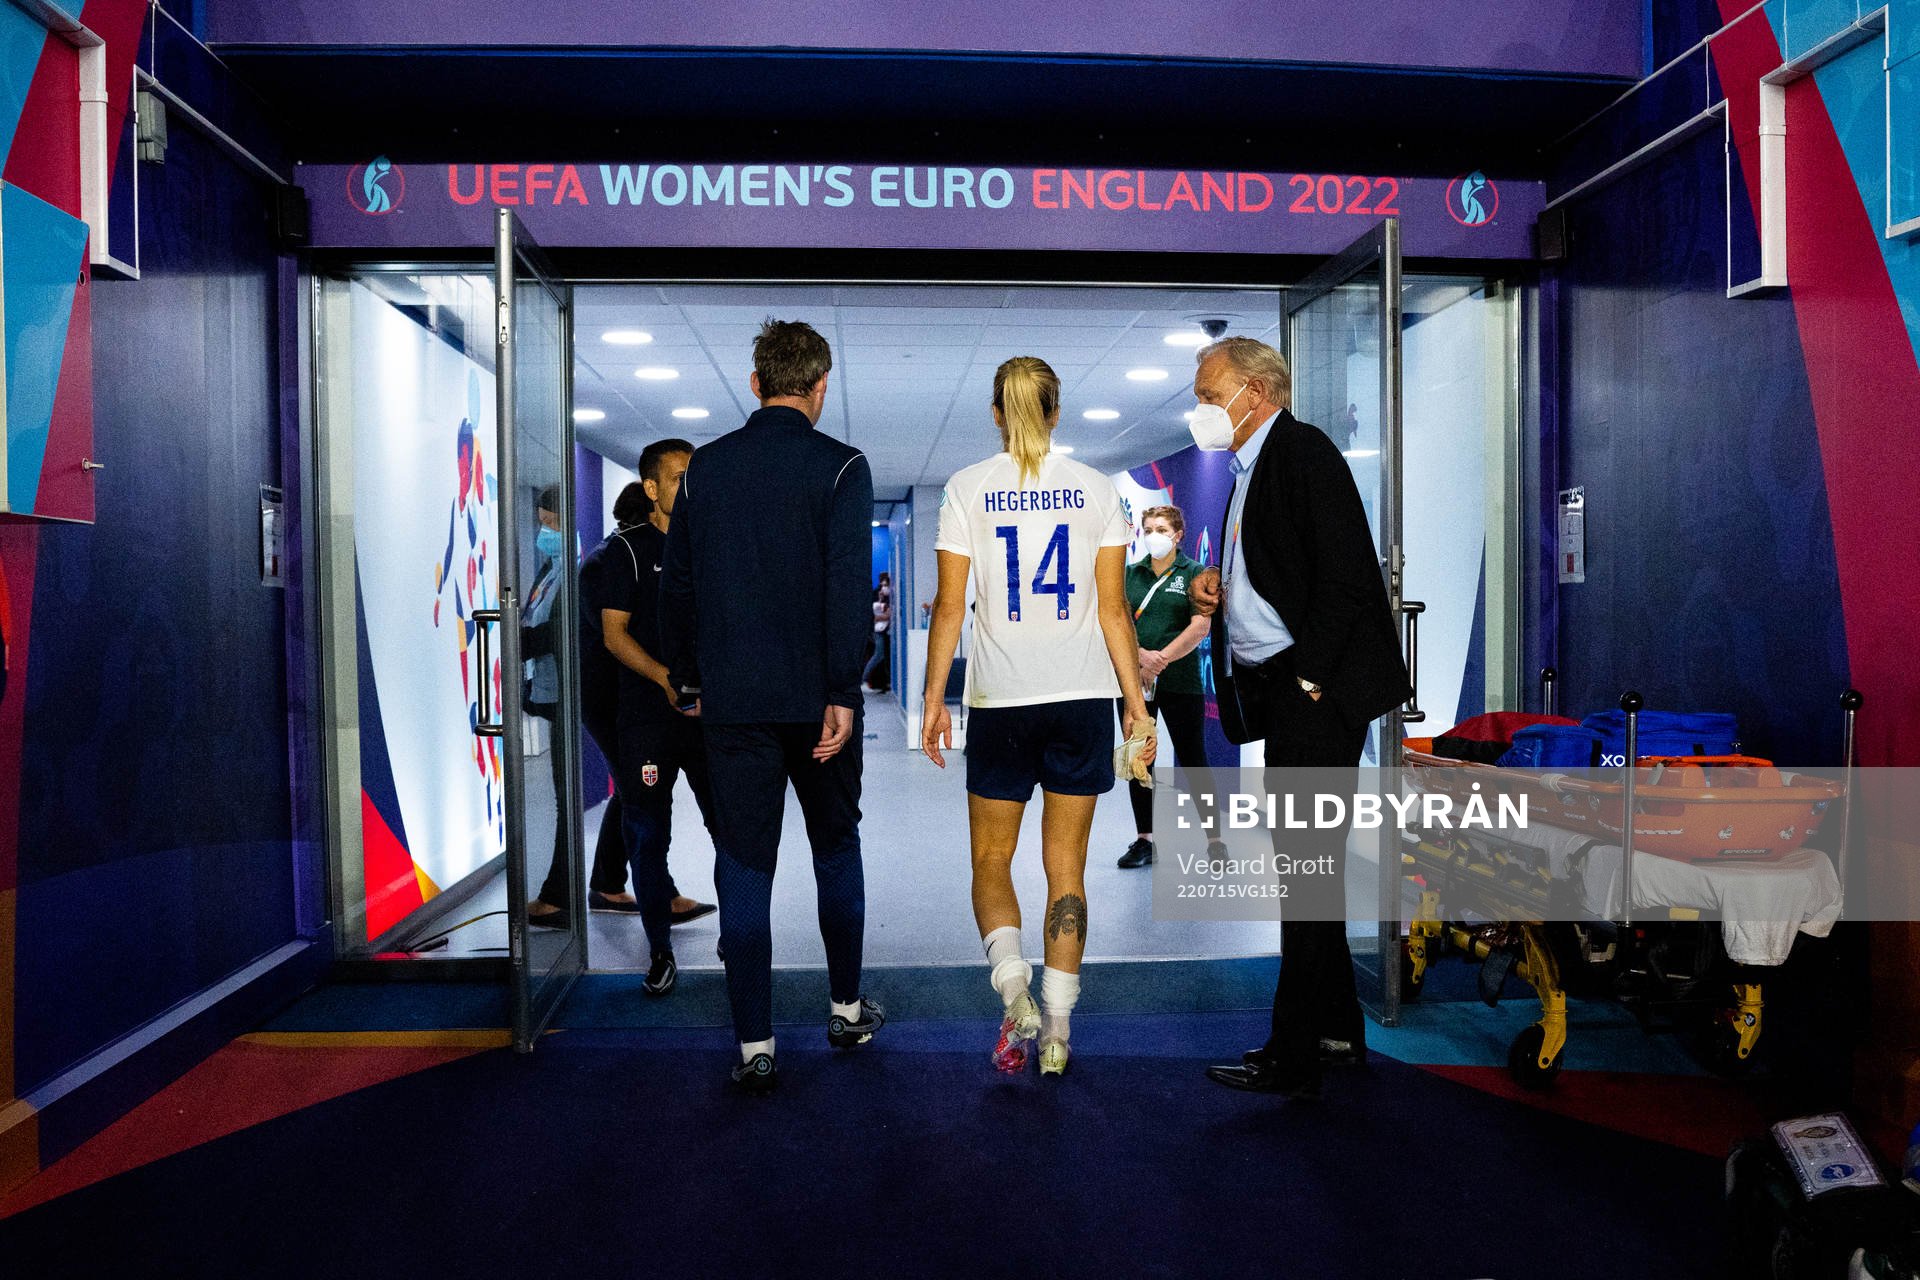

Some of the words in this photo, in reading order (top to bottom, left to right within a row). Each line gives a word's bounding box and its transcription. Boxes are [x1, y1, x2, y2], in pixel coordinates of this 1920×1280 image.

[448, 163, 590, 206] UEFA
[599, 164, 855, 207] WOMEN'S
[870, 166, 1015, 209] EURO
[1032, 168, 1275, 213] ENGLAND
[984, 489, 1085, 513] HEGERBERG
[995, 523, 1076, 622] 14
